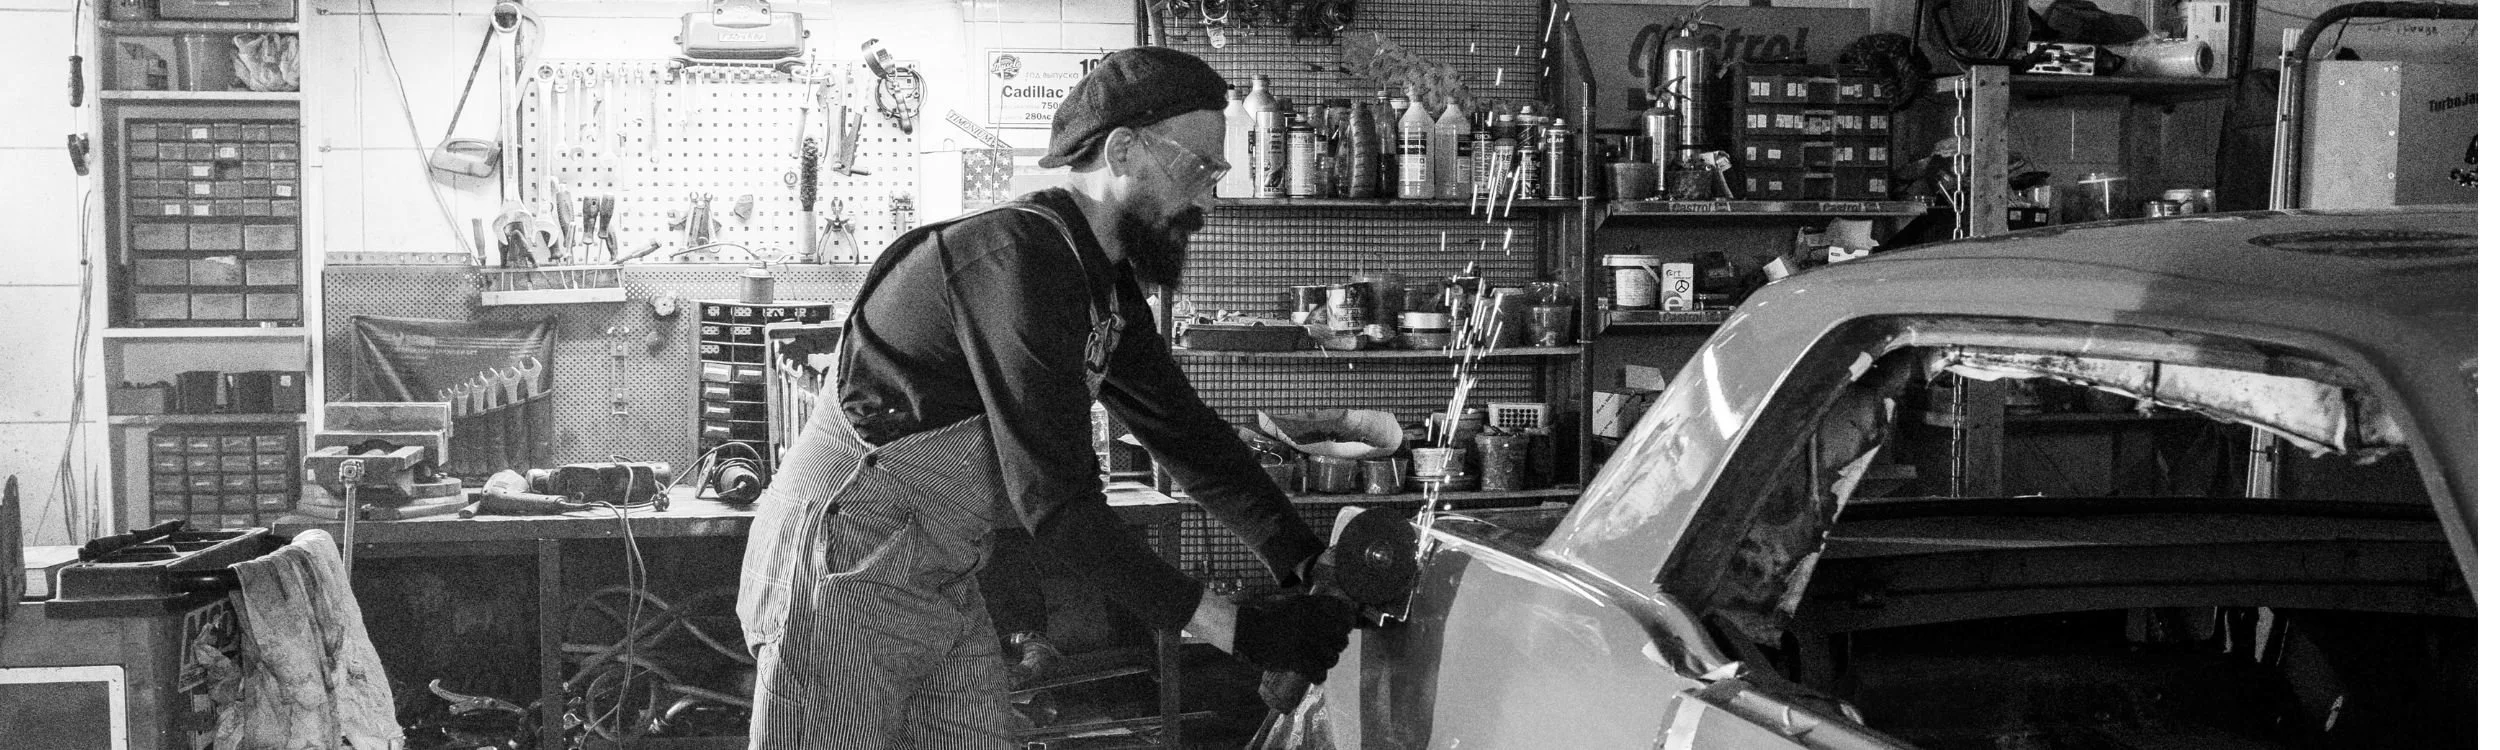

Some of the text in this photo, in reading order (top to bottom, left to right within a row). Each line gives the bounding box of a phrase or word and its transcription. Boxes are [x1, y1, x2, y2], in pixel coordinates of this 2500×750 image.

[1002, 85, 1064, 98] Cadillac
[2428, 92, 2479, 113] TurboJa
[1672, 202, 1712, 213] Castrol
[1822, 202, 1862, 213] Castrol
